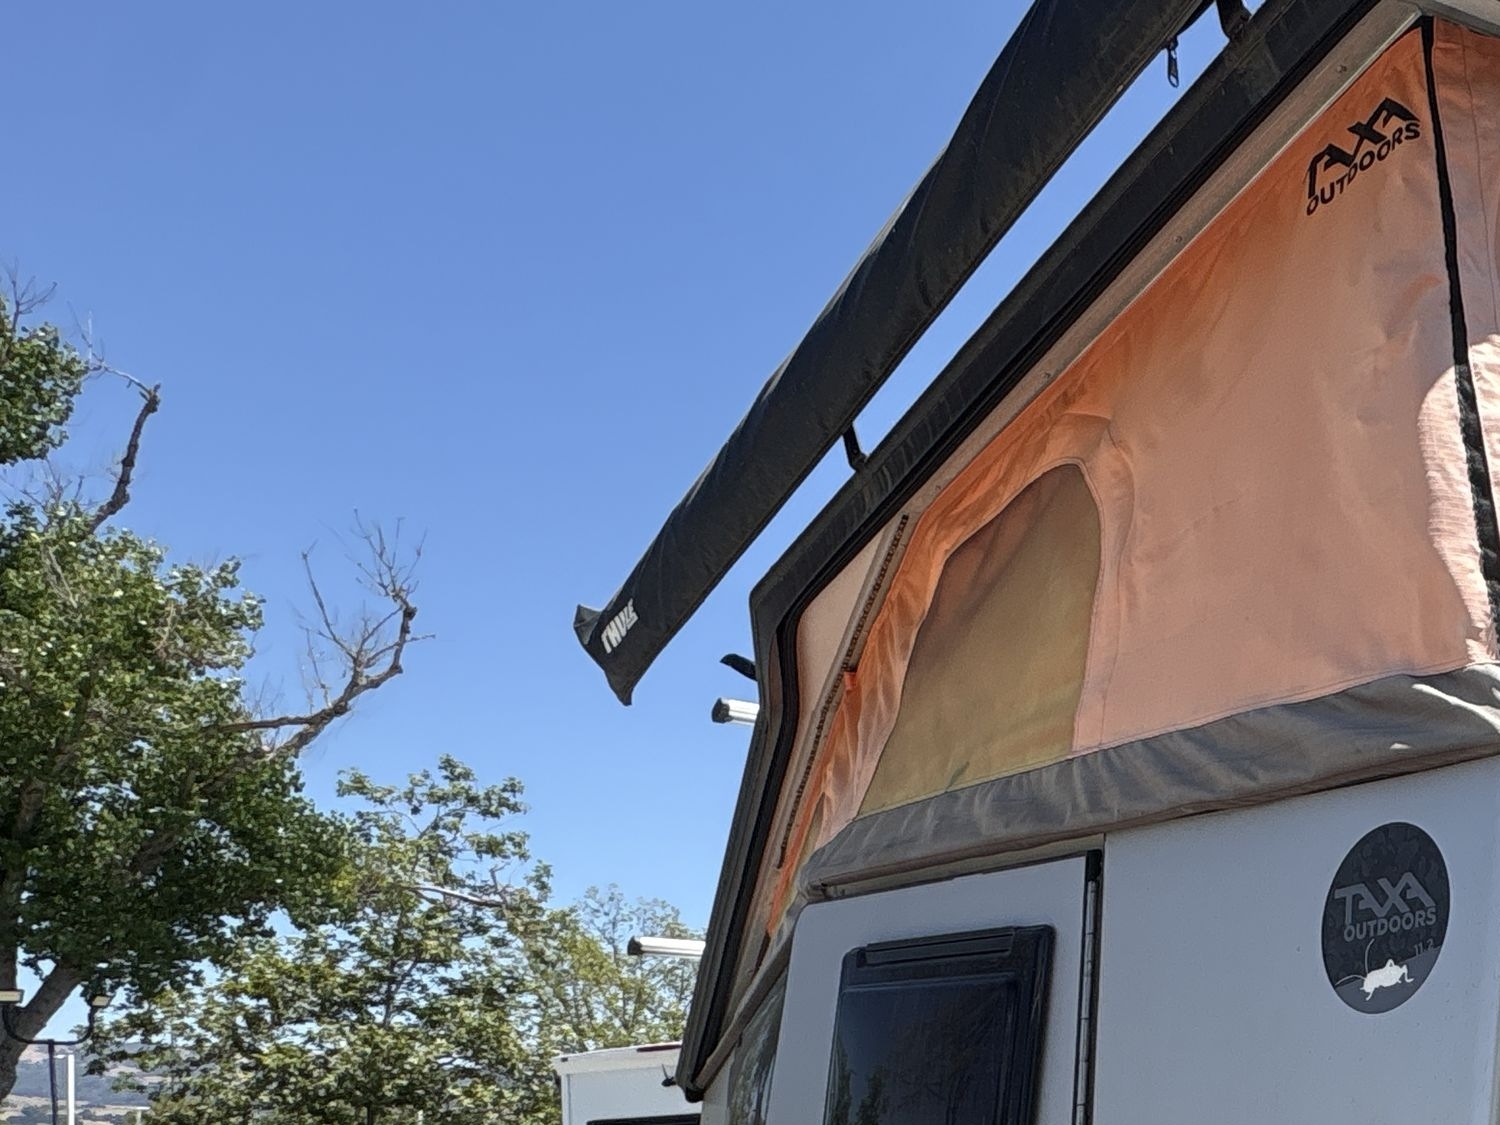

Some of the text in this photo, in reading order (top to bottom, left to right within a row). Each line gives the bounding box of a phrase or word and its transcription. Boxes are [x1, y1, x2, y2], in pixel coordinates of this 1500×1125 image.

[1306, 122, 1421, 217] OUTDOORS
[1307, 97, 1421, 200] TAXA
[1334, 871, 1437, 925] TAXA
[1343, 904, 1438, 943] OUTDOORS
